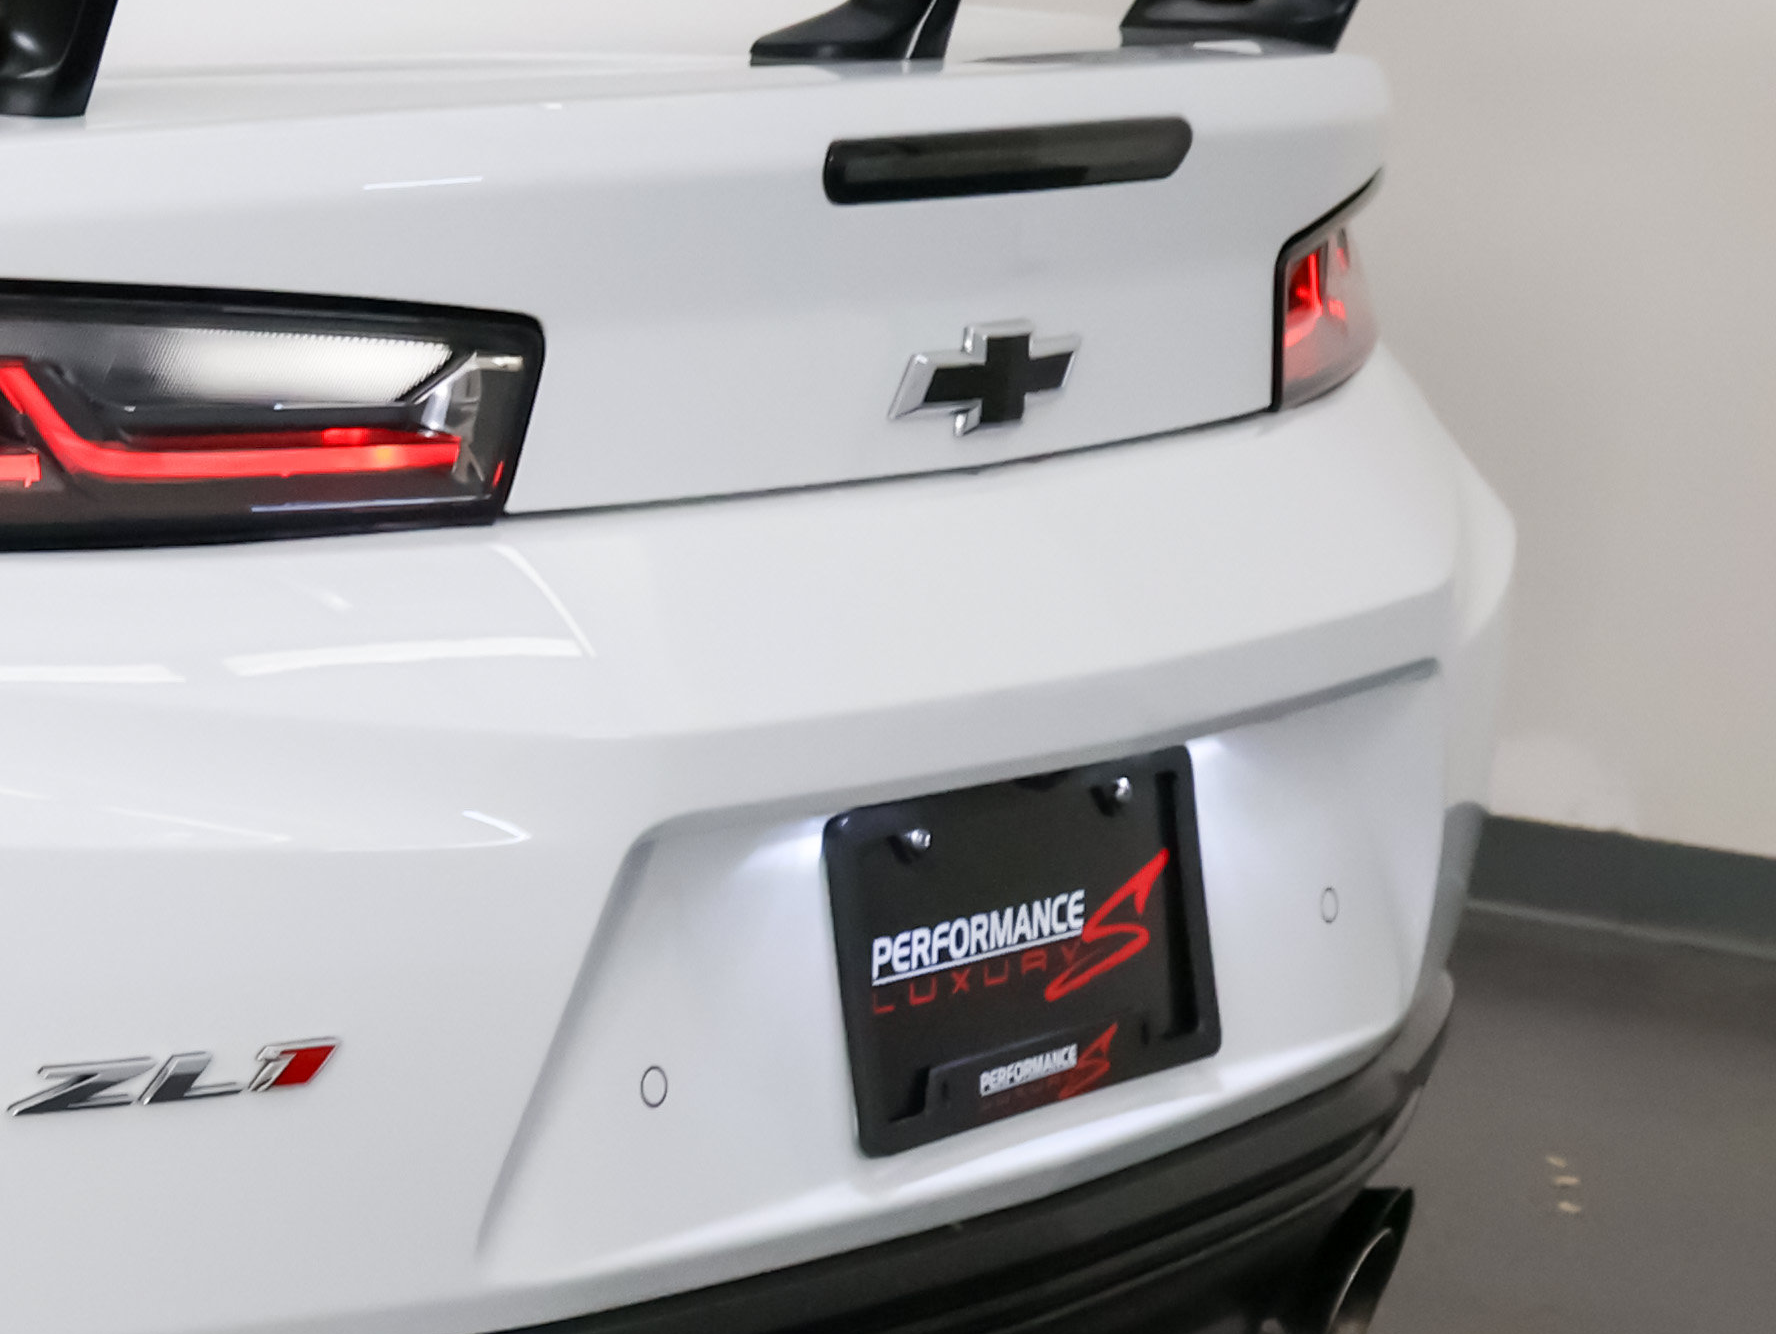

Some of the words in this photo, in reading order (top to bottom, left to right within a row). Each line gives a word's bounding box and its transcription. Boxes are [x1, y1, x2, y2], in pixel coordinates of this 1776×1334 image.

[871, 888, 1086, 981] PERFORMANCE
[872, 940, 1082, 1014] LUXURY
[5, 1035, 343, 1117] ZL1
[979, 1042, 1079, 1097] PERFORMANCE
